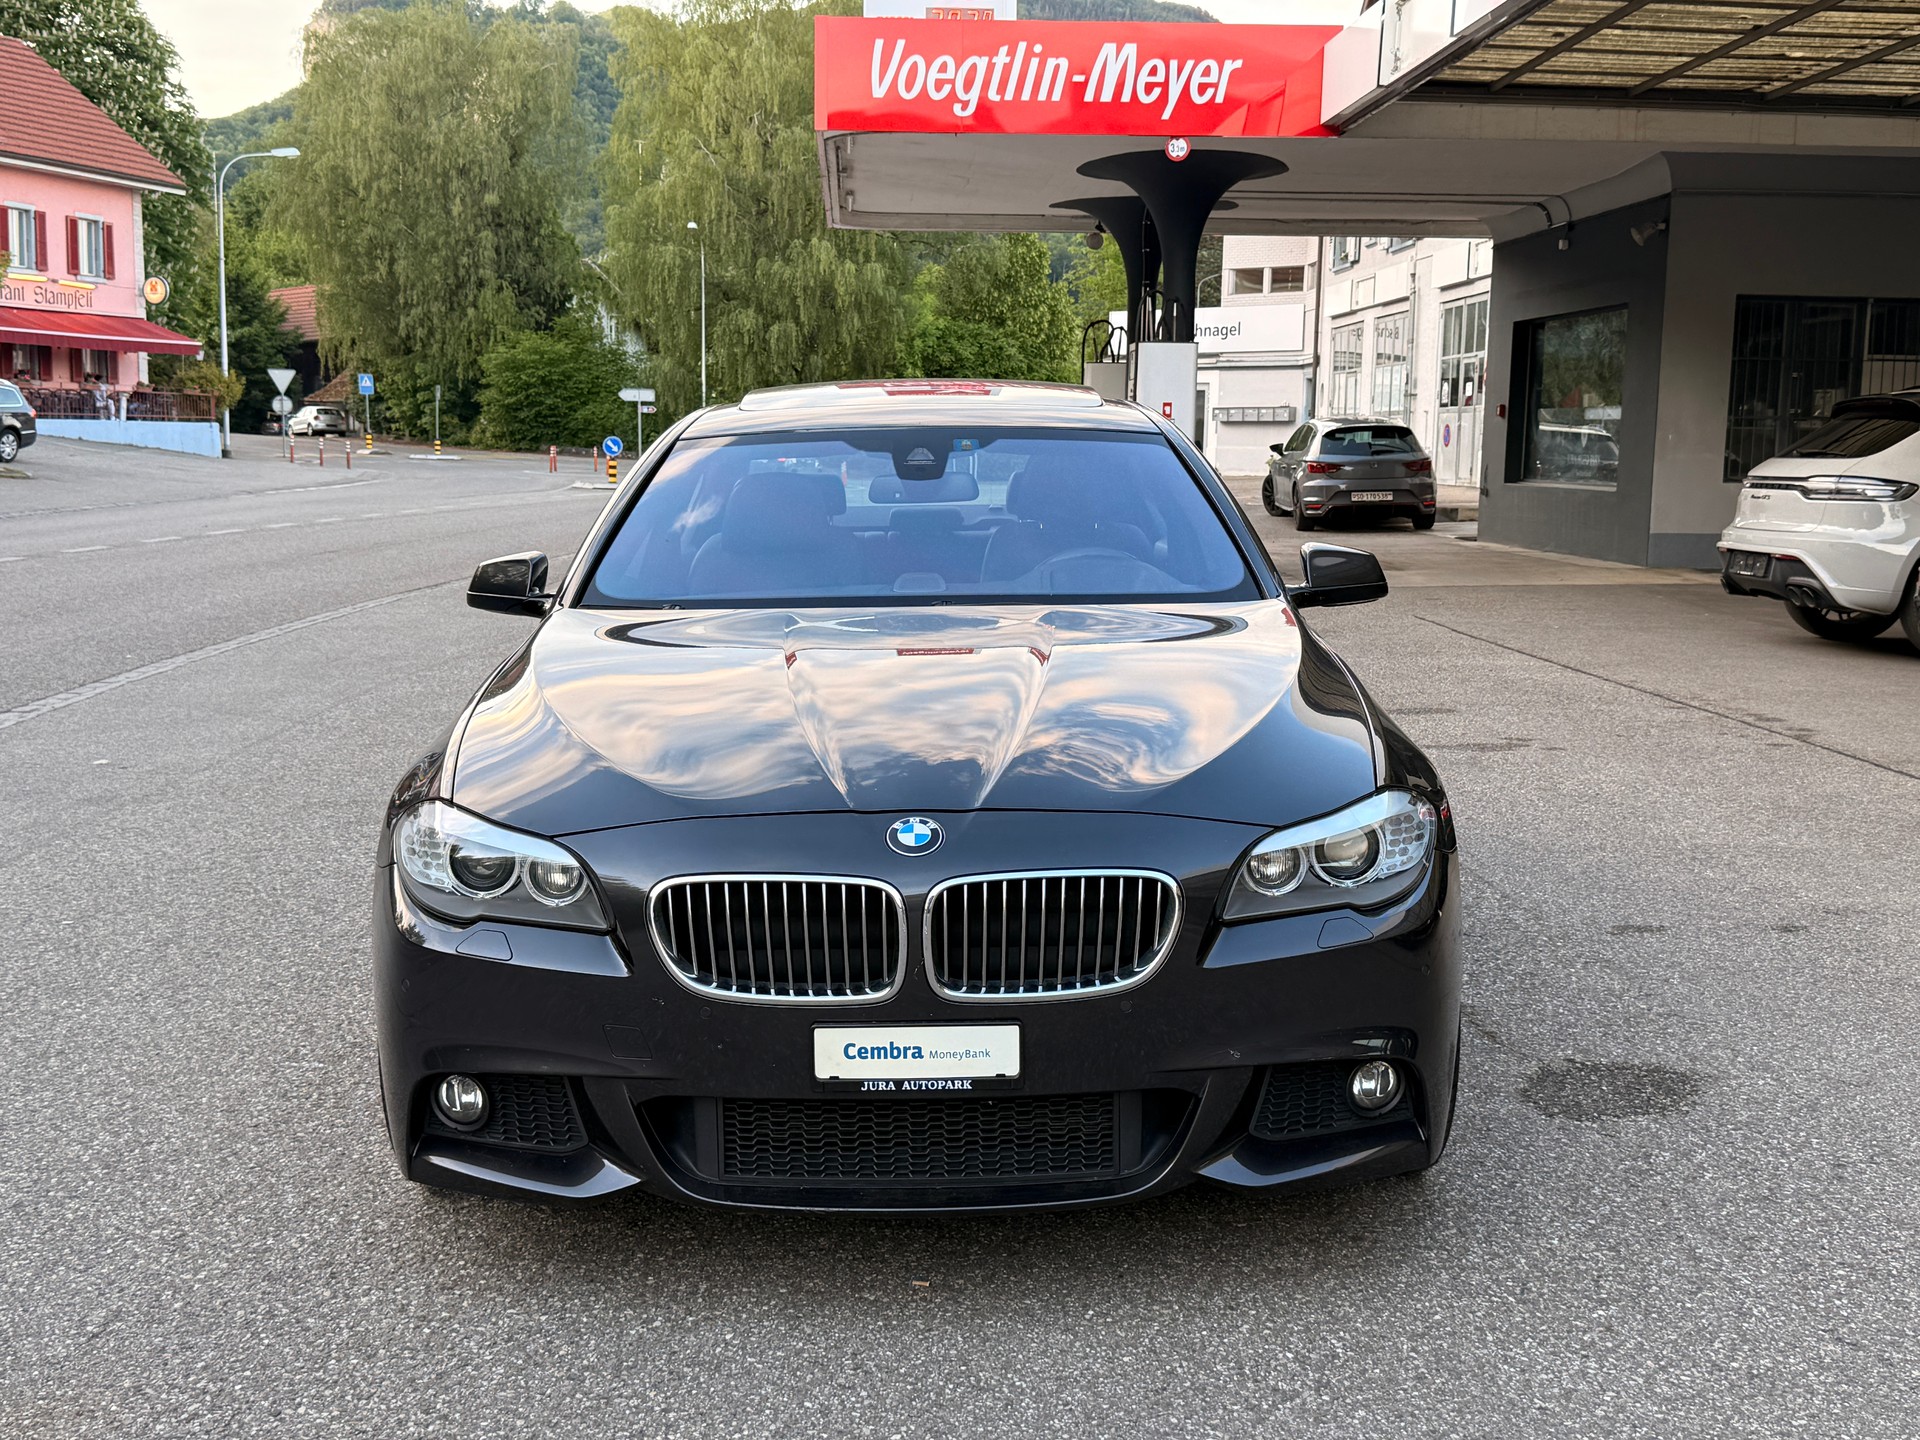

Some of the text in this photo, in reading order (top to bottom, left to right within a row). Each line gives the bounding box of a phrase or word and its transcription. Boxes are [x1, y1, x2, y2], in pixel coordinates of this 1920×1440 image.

[871, 38, 1242, 120] Voegtlin-Meyer
[1194, 321, 1241, 341] hnagel
[892, 817, 938, 829] BMW
[843, 1041, 991, 1061] Cembra MoneyBank
[861, 1080, 973, 1091] JURA AUTOPARK
